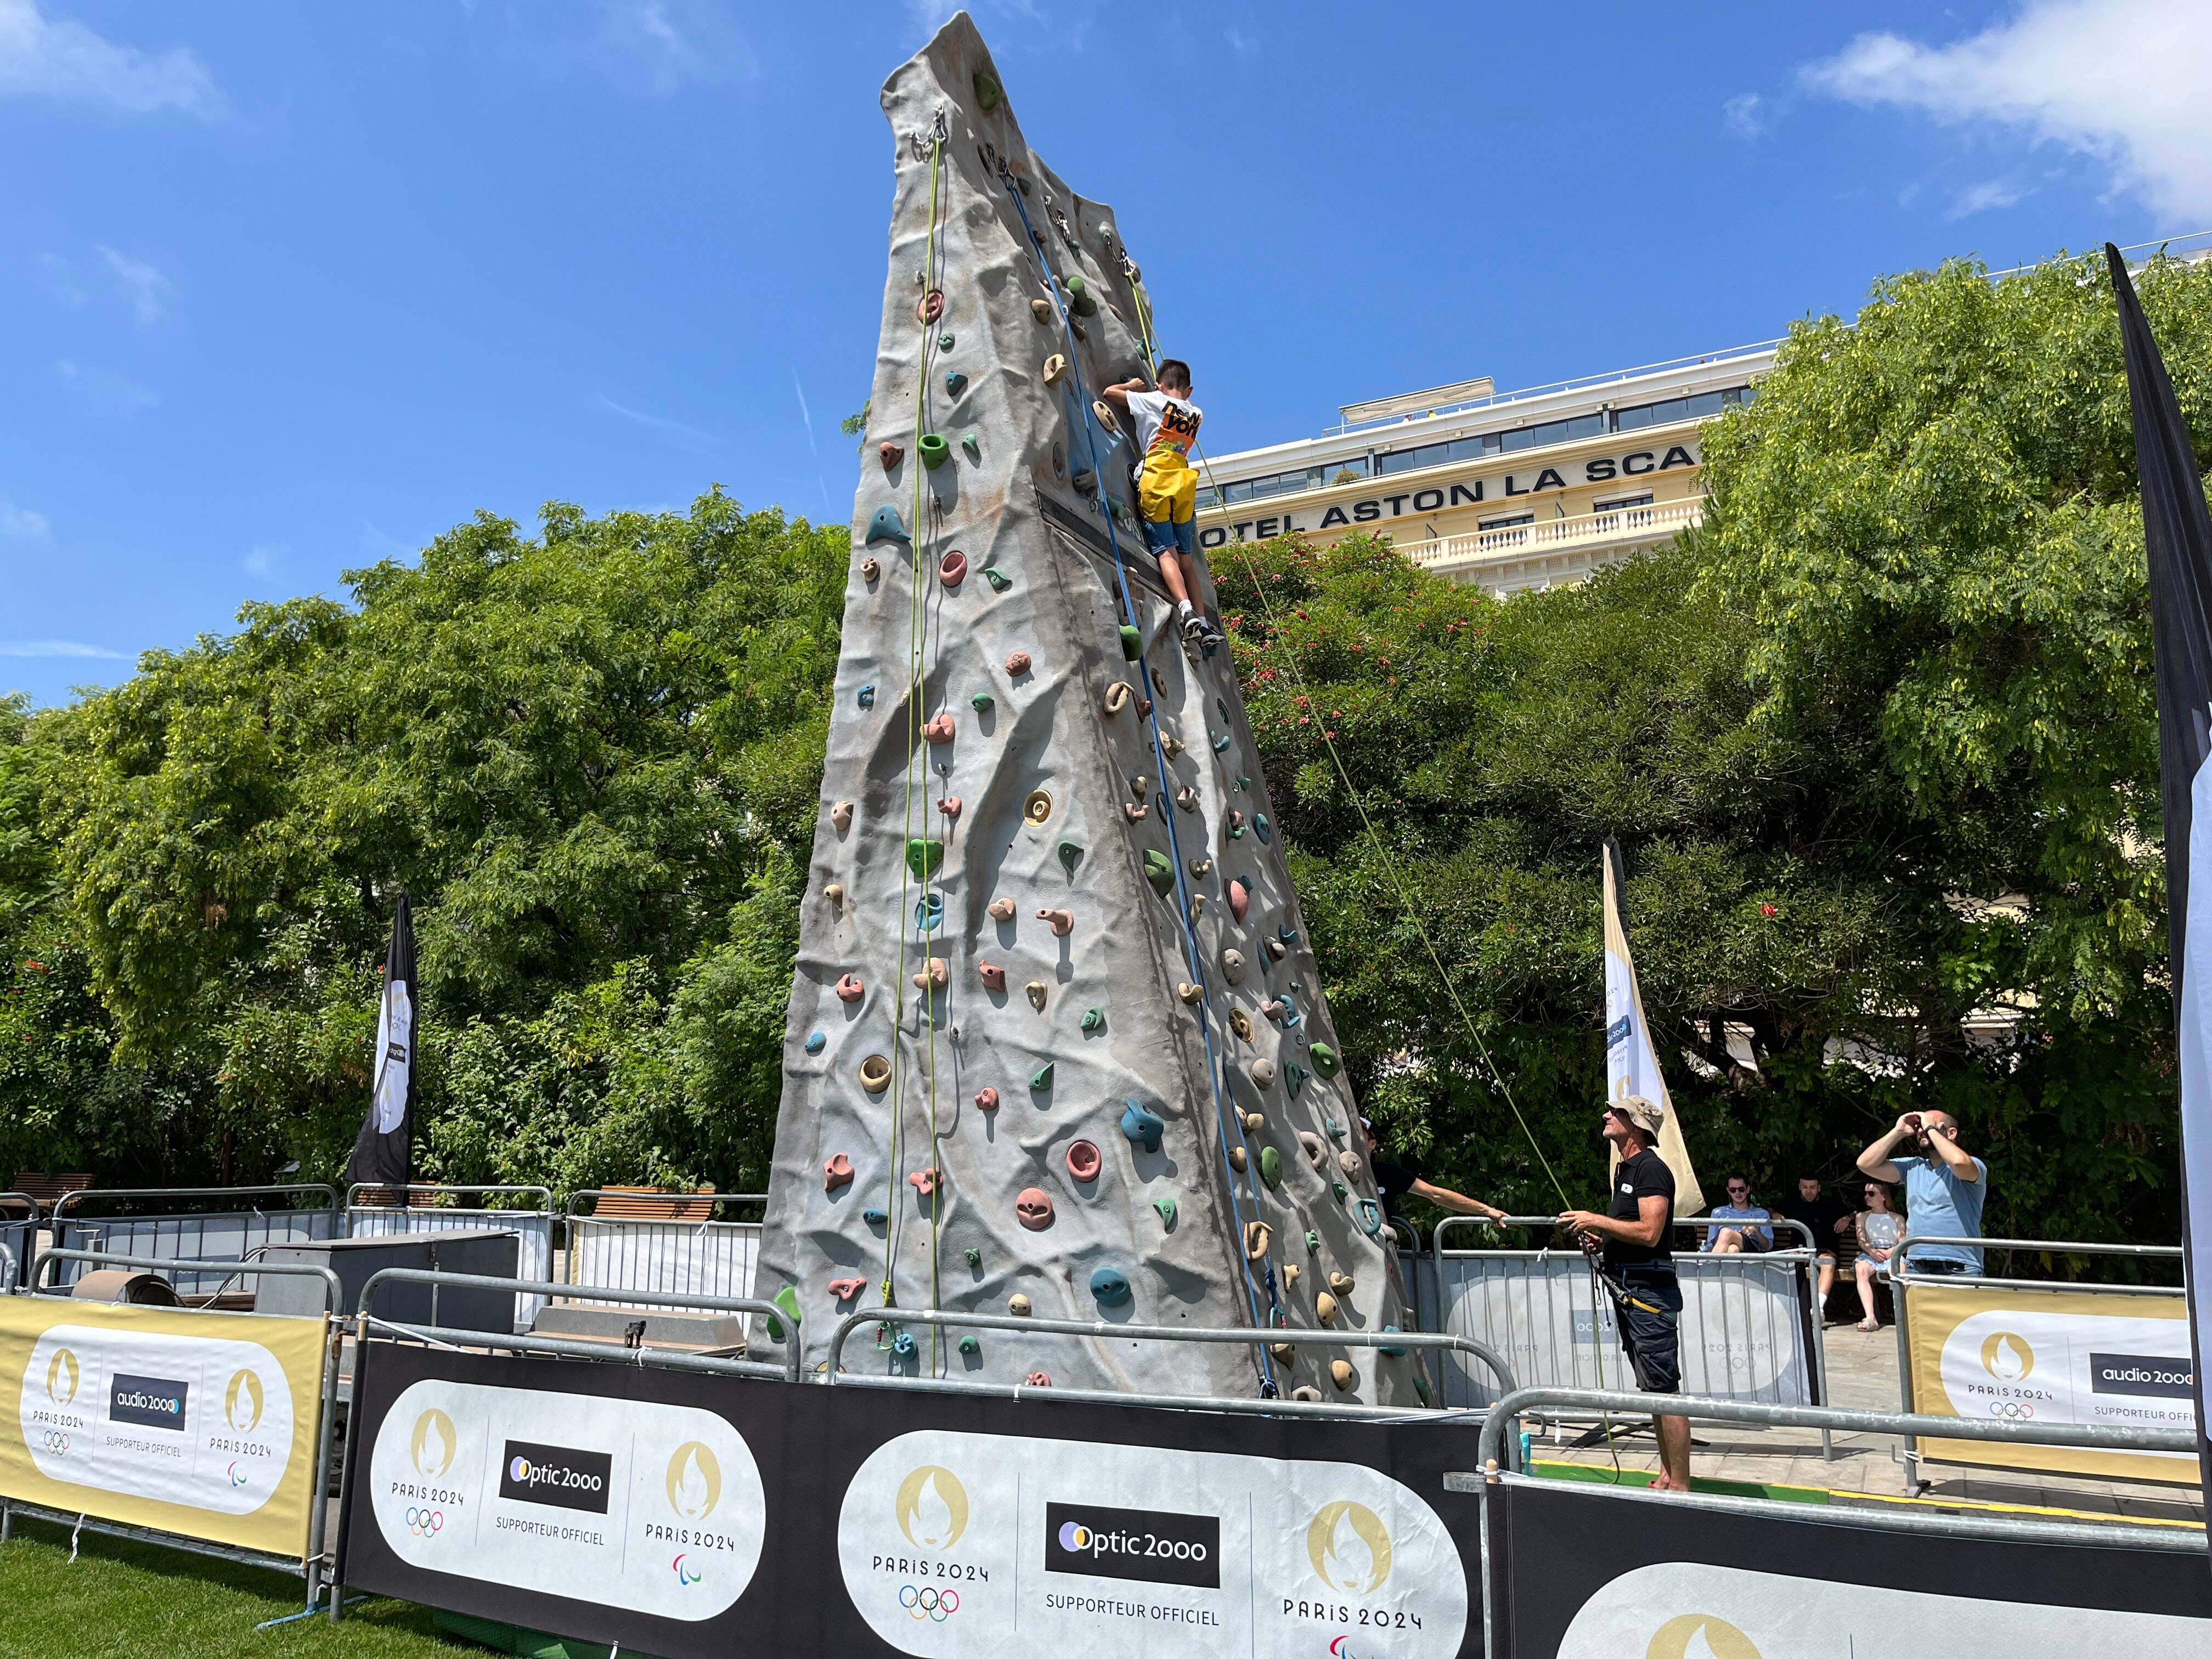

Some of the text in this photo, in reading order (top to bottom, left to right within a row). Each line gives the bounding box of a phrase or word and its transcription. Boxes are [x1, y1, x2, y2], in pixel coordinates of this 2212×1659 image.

[1319, 481, 1483, 528] ASTON
[1505, 468, 1566, 496] LA
[1585, 446, 1695, 482] SCA
[2102, 1368, 2193, 1385] audio 2000
[117, 1391, 175, 1413] audio 2000
[2015, 1389, 2053, 1401] 2024
[61, 1414, 84, 1429] 2024
[2095, 1406, 2196, 1421] SUPPORTEUR OFFI
[106, 1436, 182, 1458] SUPPORTEUR OFFICIEL
[243, 1443, 272, 1457] 2024
[518, 1460, 602, 1491] Optic 2000
[431, 1488, 464, 1506] 2024
[496, 1516, 605, 1546] SUPPORTEUR OFFICIEL
[694, 1532, 734, 1551] 2024
[1073, 1526, 1207, 1561] Optic 2000
[936, 1562, 988, 1582] 2024
[1046, 1594, 1220, 1626] SUPPORTEUR OFFICIEL
[1359, 1609, 1421, 1630] 2024
